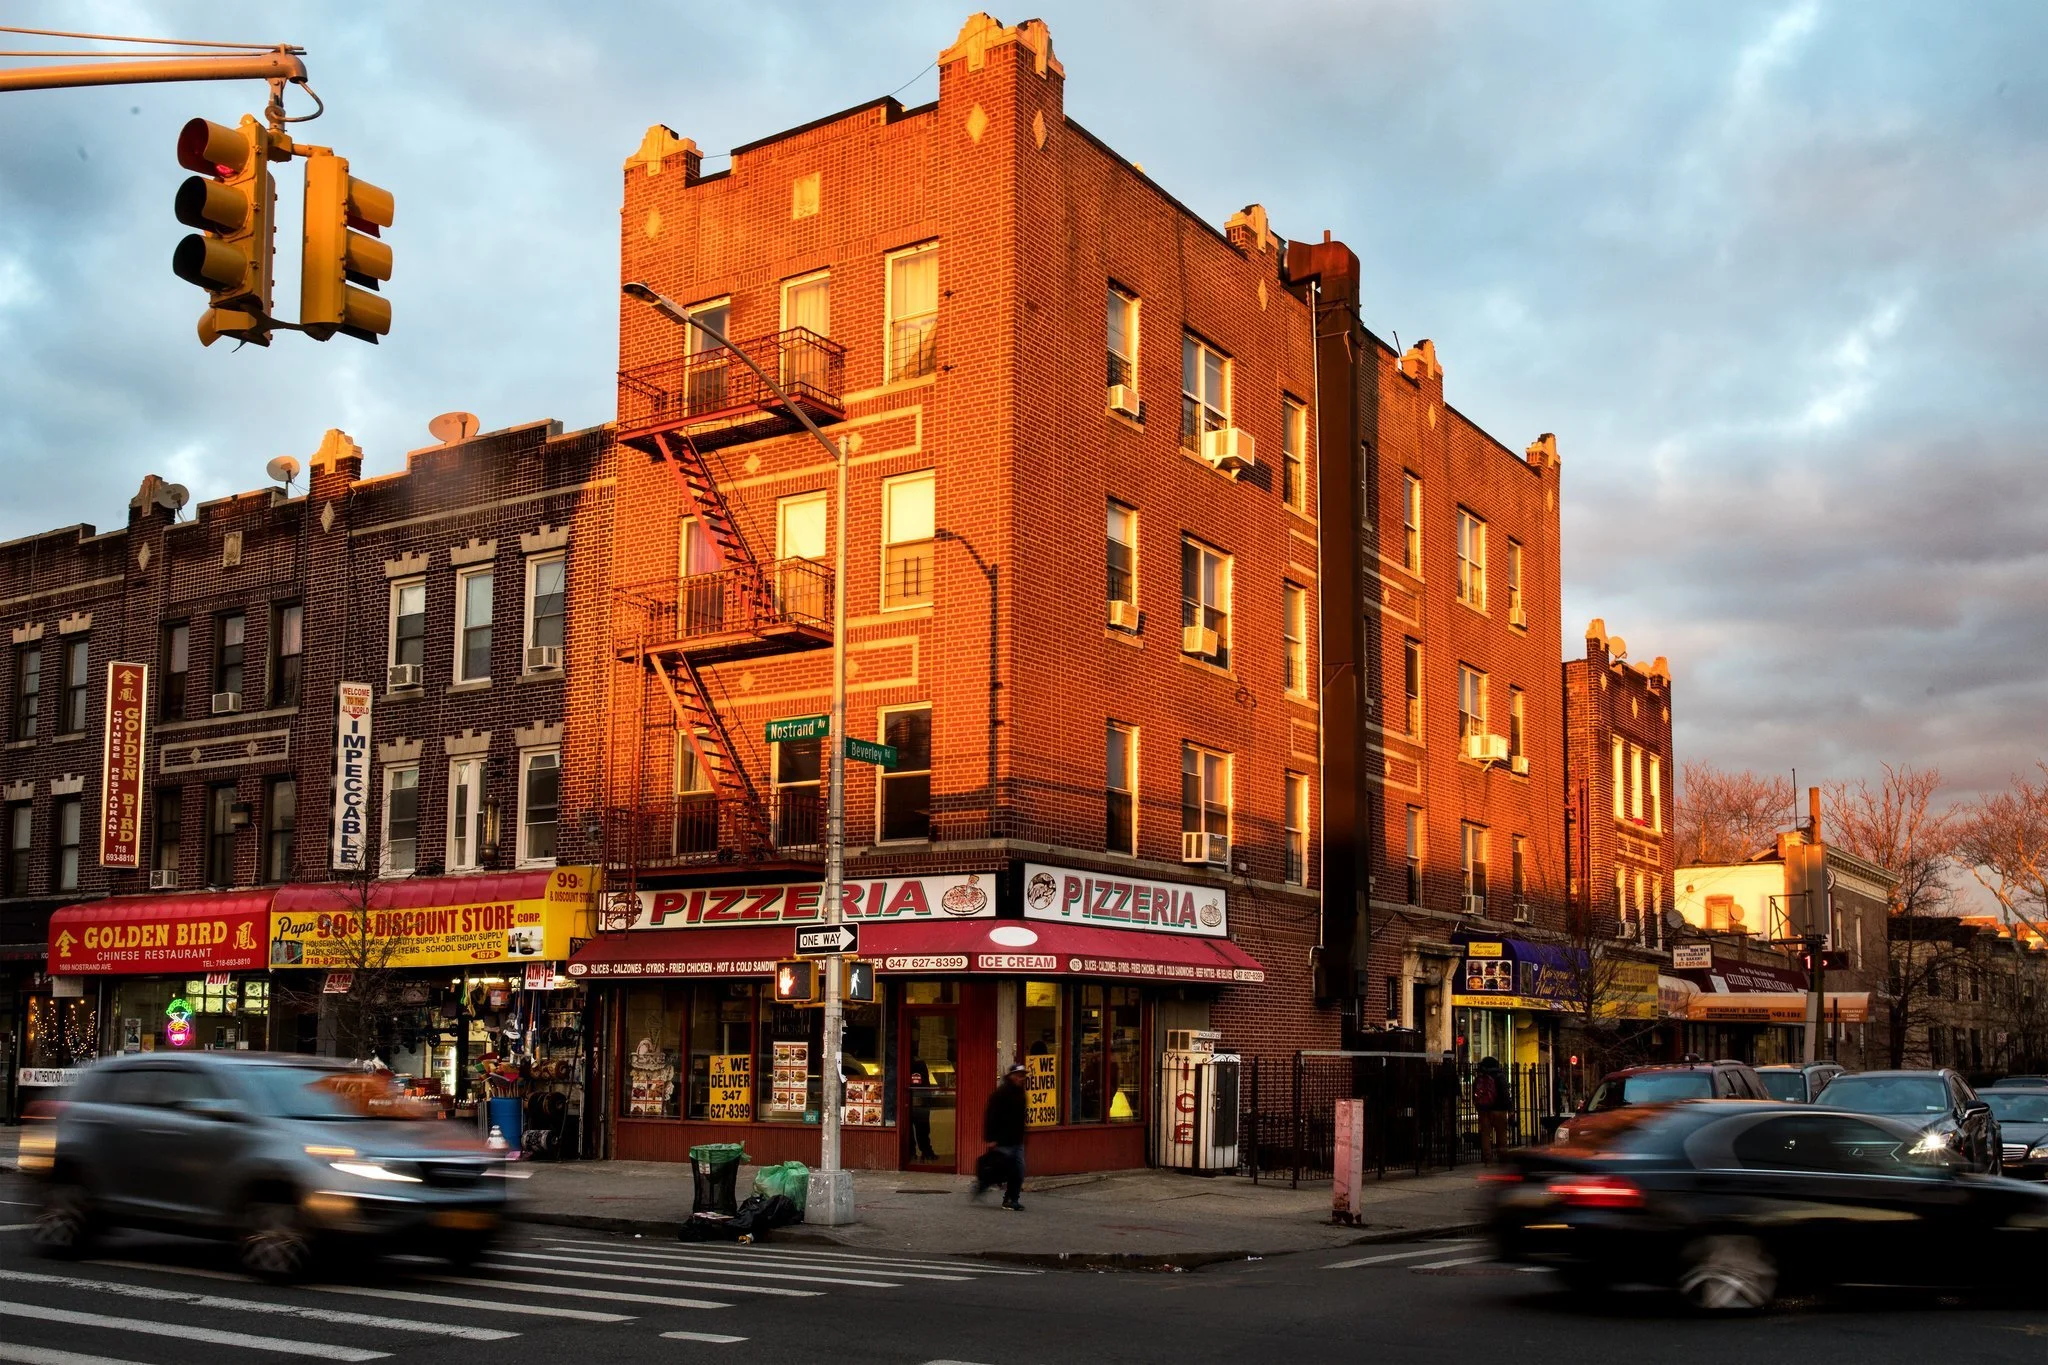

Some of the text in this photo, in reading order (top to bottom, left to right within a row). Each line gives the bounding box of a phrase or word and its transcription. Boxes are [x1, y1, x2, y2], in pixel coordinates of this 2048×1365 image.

[342, 687, 370, 697] WELCOME
[341, 705, 370, 715] ALL WORLD
[770, 719, 826, 739] Nostrand Av
[851, 741, 883, 764] Beverley
[108, 710, 123, 837] CHINESE RESTAURANT
[119, 707, 140, 842] GOLDEN BIRD
[340, 720, 366, 864] IMPECCABLE
[115, 845, 127, 853] 718
[105, 853, 135, 863] 693-8810
[555, 891, 579, 902] DISCOUNT
[579, 891, 595, 903] STORE
[650, 880, 932, 926] PIZZERIA
[1061, 875, 1198, 929] PIZZERIA
[274, 916, 315, 942] Papa
[375, 909, 458, 937] DISCOUNT
[461, 904, 515, 933] STORE
[517, 913, 541, 923] CORP.
[83, 921, 228, 949] GOLDEN BIRD
[416, 936, 440, 945] SUPPLY
[445, 934, 477, 943] BIRTHDAY
[478, 931, 504, 940] SUPPLY
[802, 933, 841, 946] ONE WAY
[425, 944, 456, 953] SCHOOL
[457, 942, 485, 952] SUPPLY
[486, 940, 502, 949] ETC
[96, 948, 213, 961] CHINESE RESTAURANT
[476, 951, 496, 960] 1673
[71, 963, 100, 971] NOSTRAND
[202, 957, 251, 968] TEL: 718-693-8810
[571, 965, 584, 974] 1675
[590, 964, 610, 974] SLICES
[613, 963, 642, 974] CALZONES
[645, 963, 665, 974] GYROS
[669, 963, 686, 973] FRIED
[686, 962, 713, 973] CHICKEN
[716, 962, 729, 973] HOT
[730, 962, 735, 972] &
[736, 961, 752, 972] COLD
[888, 958, 907, 968] 347
[911, 957, 963, 968] 627-8399
[981, 956, 1054, 968] ICE CREAM
[526, 964, 541, 980] ATM
[207, 973, 229, 985] ATM
[327, 974, 353, 984] ATM
[1726, 973, 1754, 987] CITIZENS
[1201, 1040, 1213, 1051] ICE
[730, 1057, 749, 1072] WE
[1039, 1057, 1054, 1072] WE
[711, 1074, 750, 1089] DELIVER
[1025, 1075, 1055, 1091] DELIVER
[722, 1090, 741, 1101] 347
[1032, 1093, 1047, 1104] 347
[1175, 1063, 1196, 1144] ICE
[710, 1103, 750, 1119] 627-8399
[1025, 1107, 1056, 1124] 627-8399
